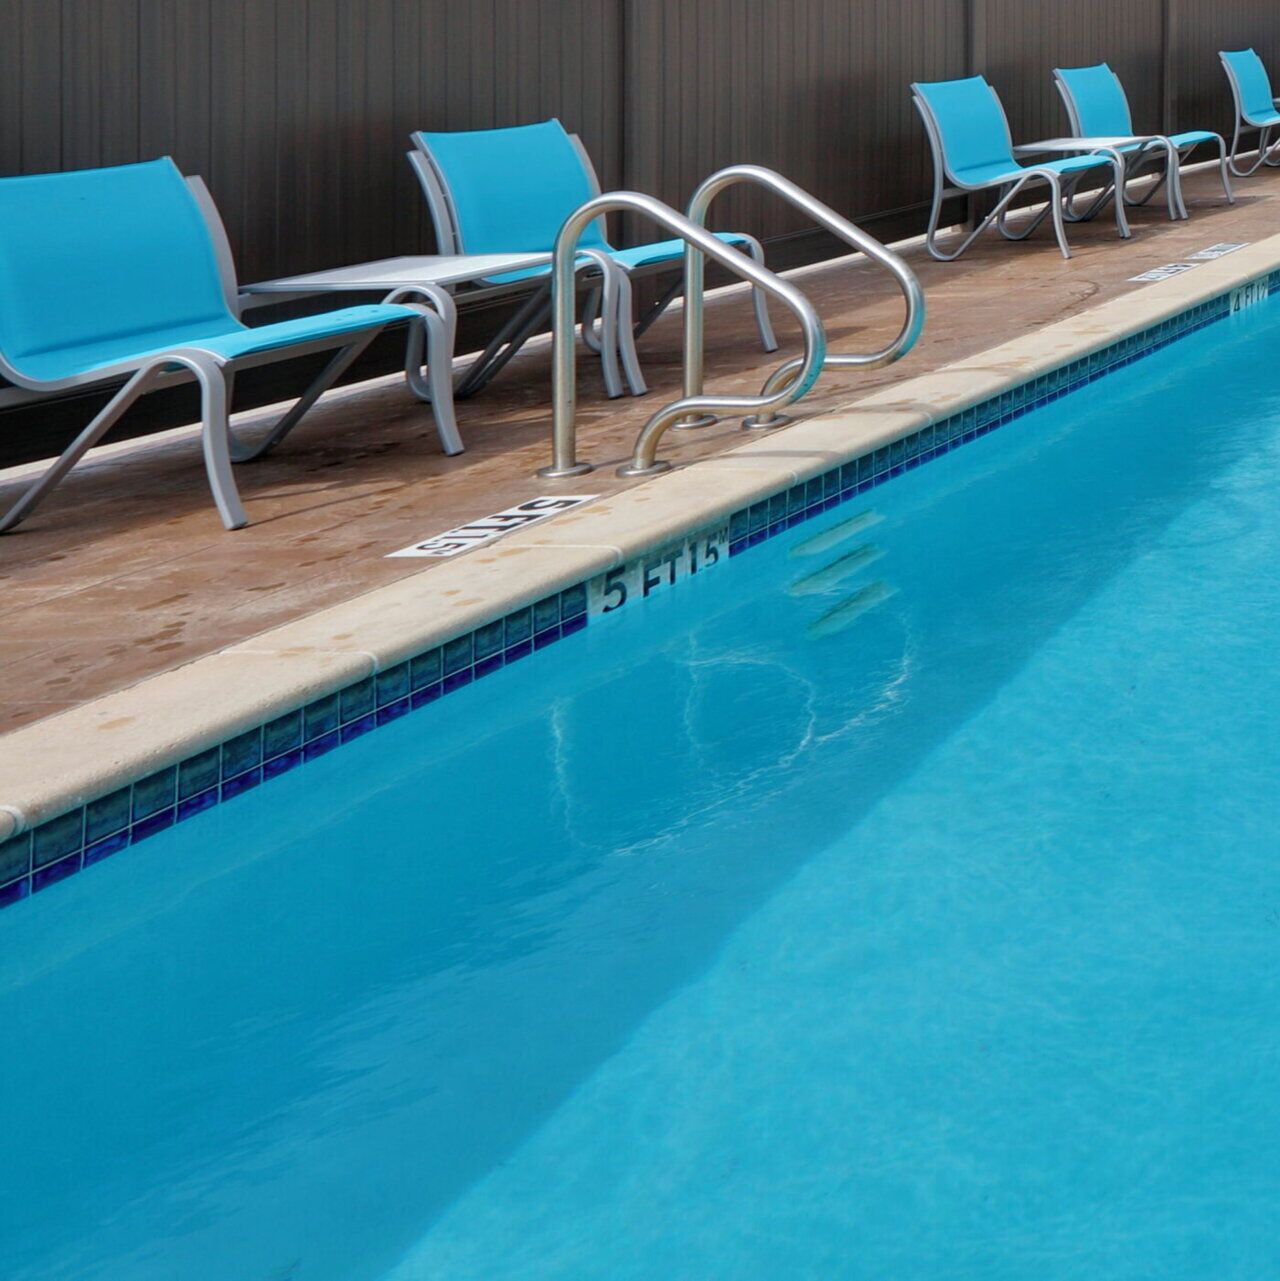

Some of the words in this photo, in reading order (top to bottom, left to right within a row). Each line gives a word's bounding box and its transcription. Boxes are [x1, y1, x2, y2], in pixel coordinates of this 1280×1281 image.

[518, 499, 583, 511] 5
[602, 565, 627, 613] 5
[643, 549, 684, 598] FT
